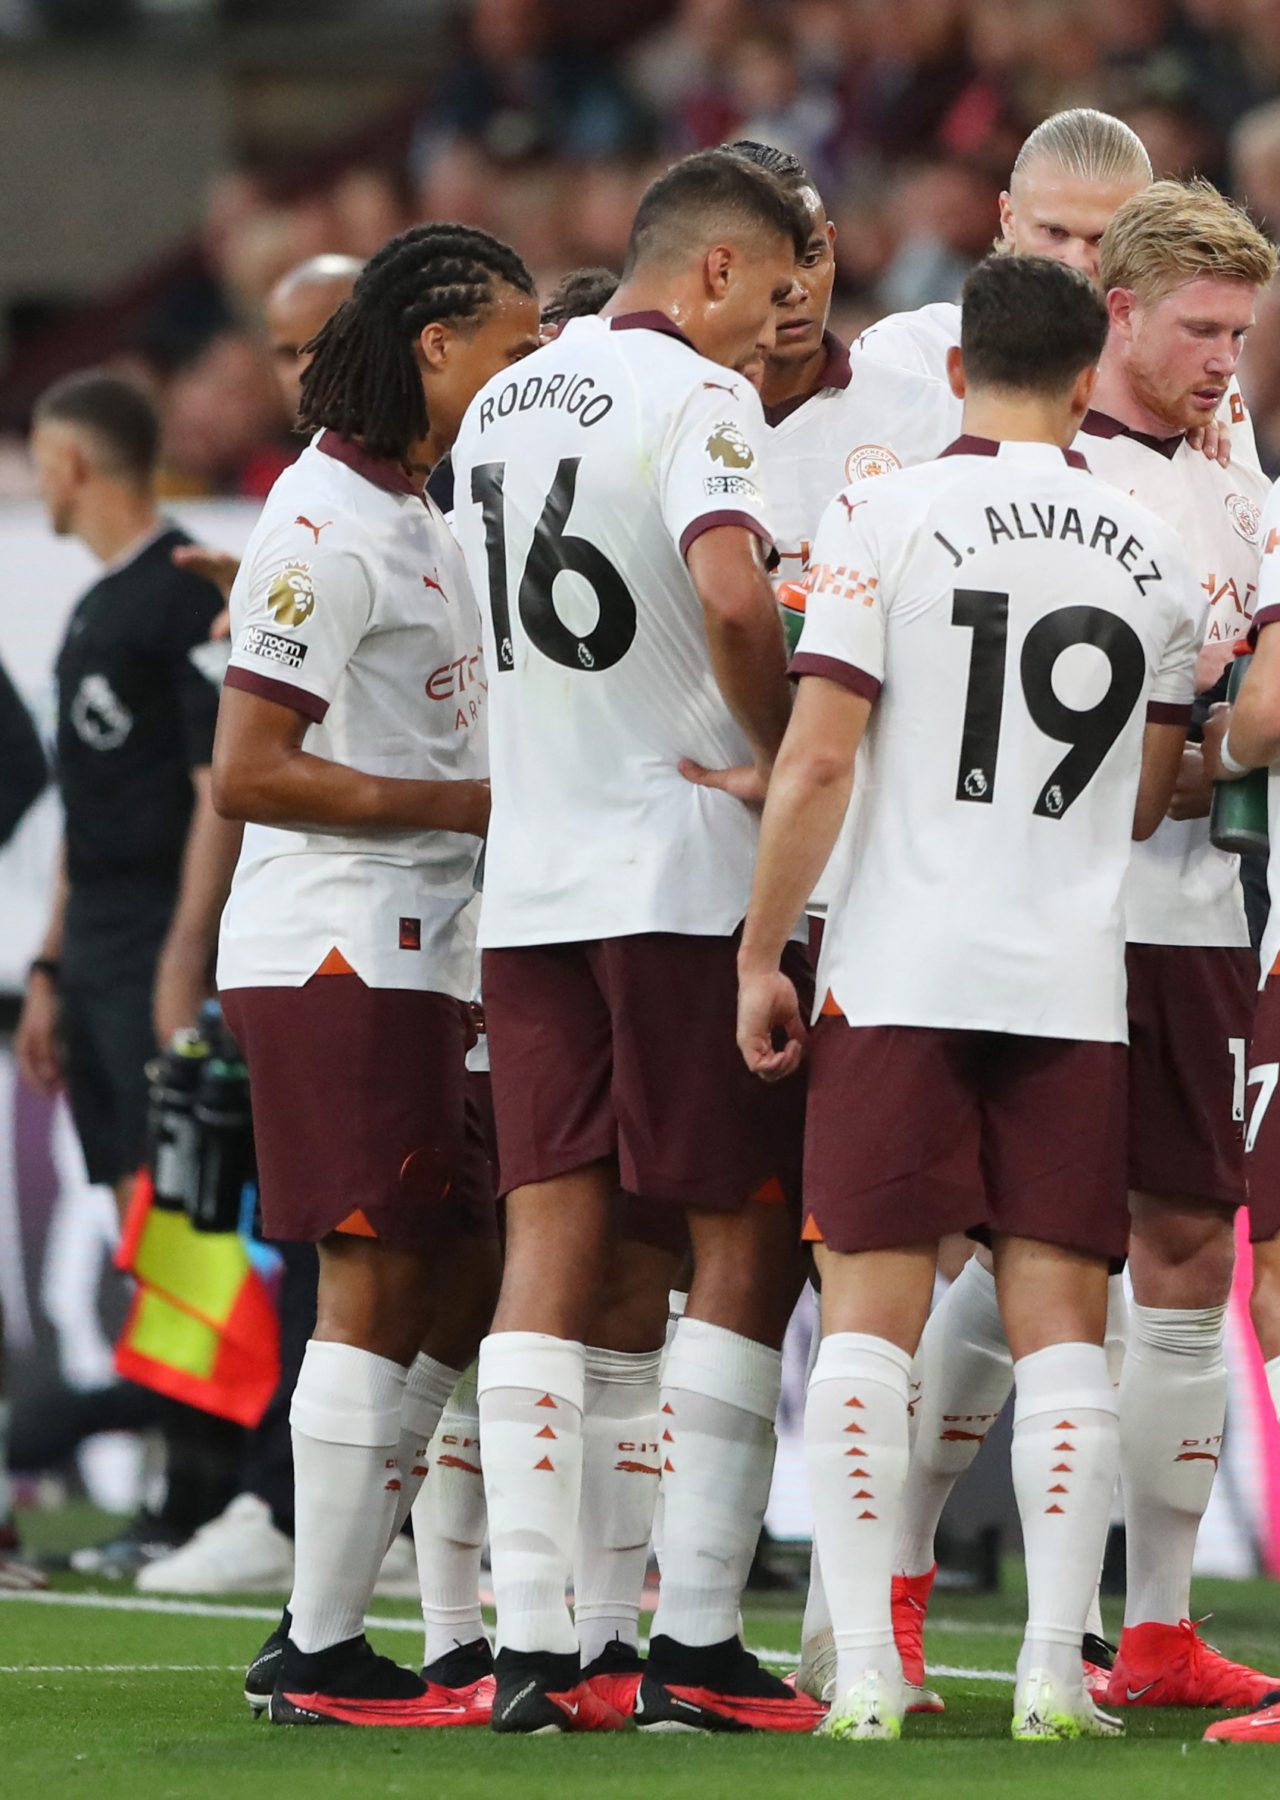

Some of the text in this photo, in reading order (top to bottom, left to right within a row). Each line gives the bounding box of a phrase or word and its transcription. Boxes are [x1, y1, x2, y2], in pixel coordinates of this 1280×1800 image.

[479, 374, 614, 433] RODRIGO
[471, 456, 637, 672] 16
[933, 510, 976, 568] J.
[984, 502, 1163, 597] ALVAREZ
[242, 640, 303, 669] for racism
[247, 627, 301, 657] No room
[951, 588, 1146, 820] 19
